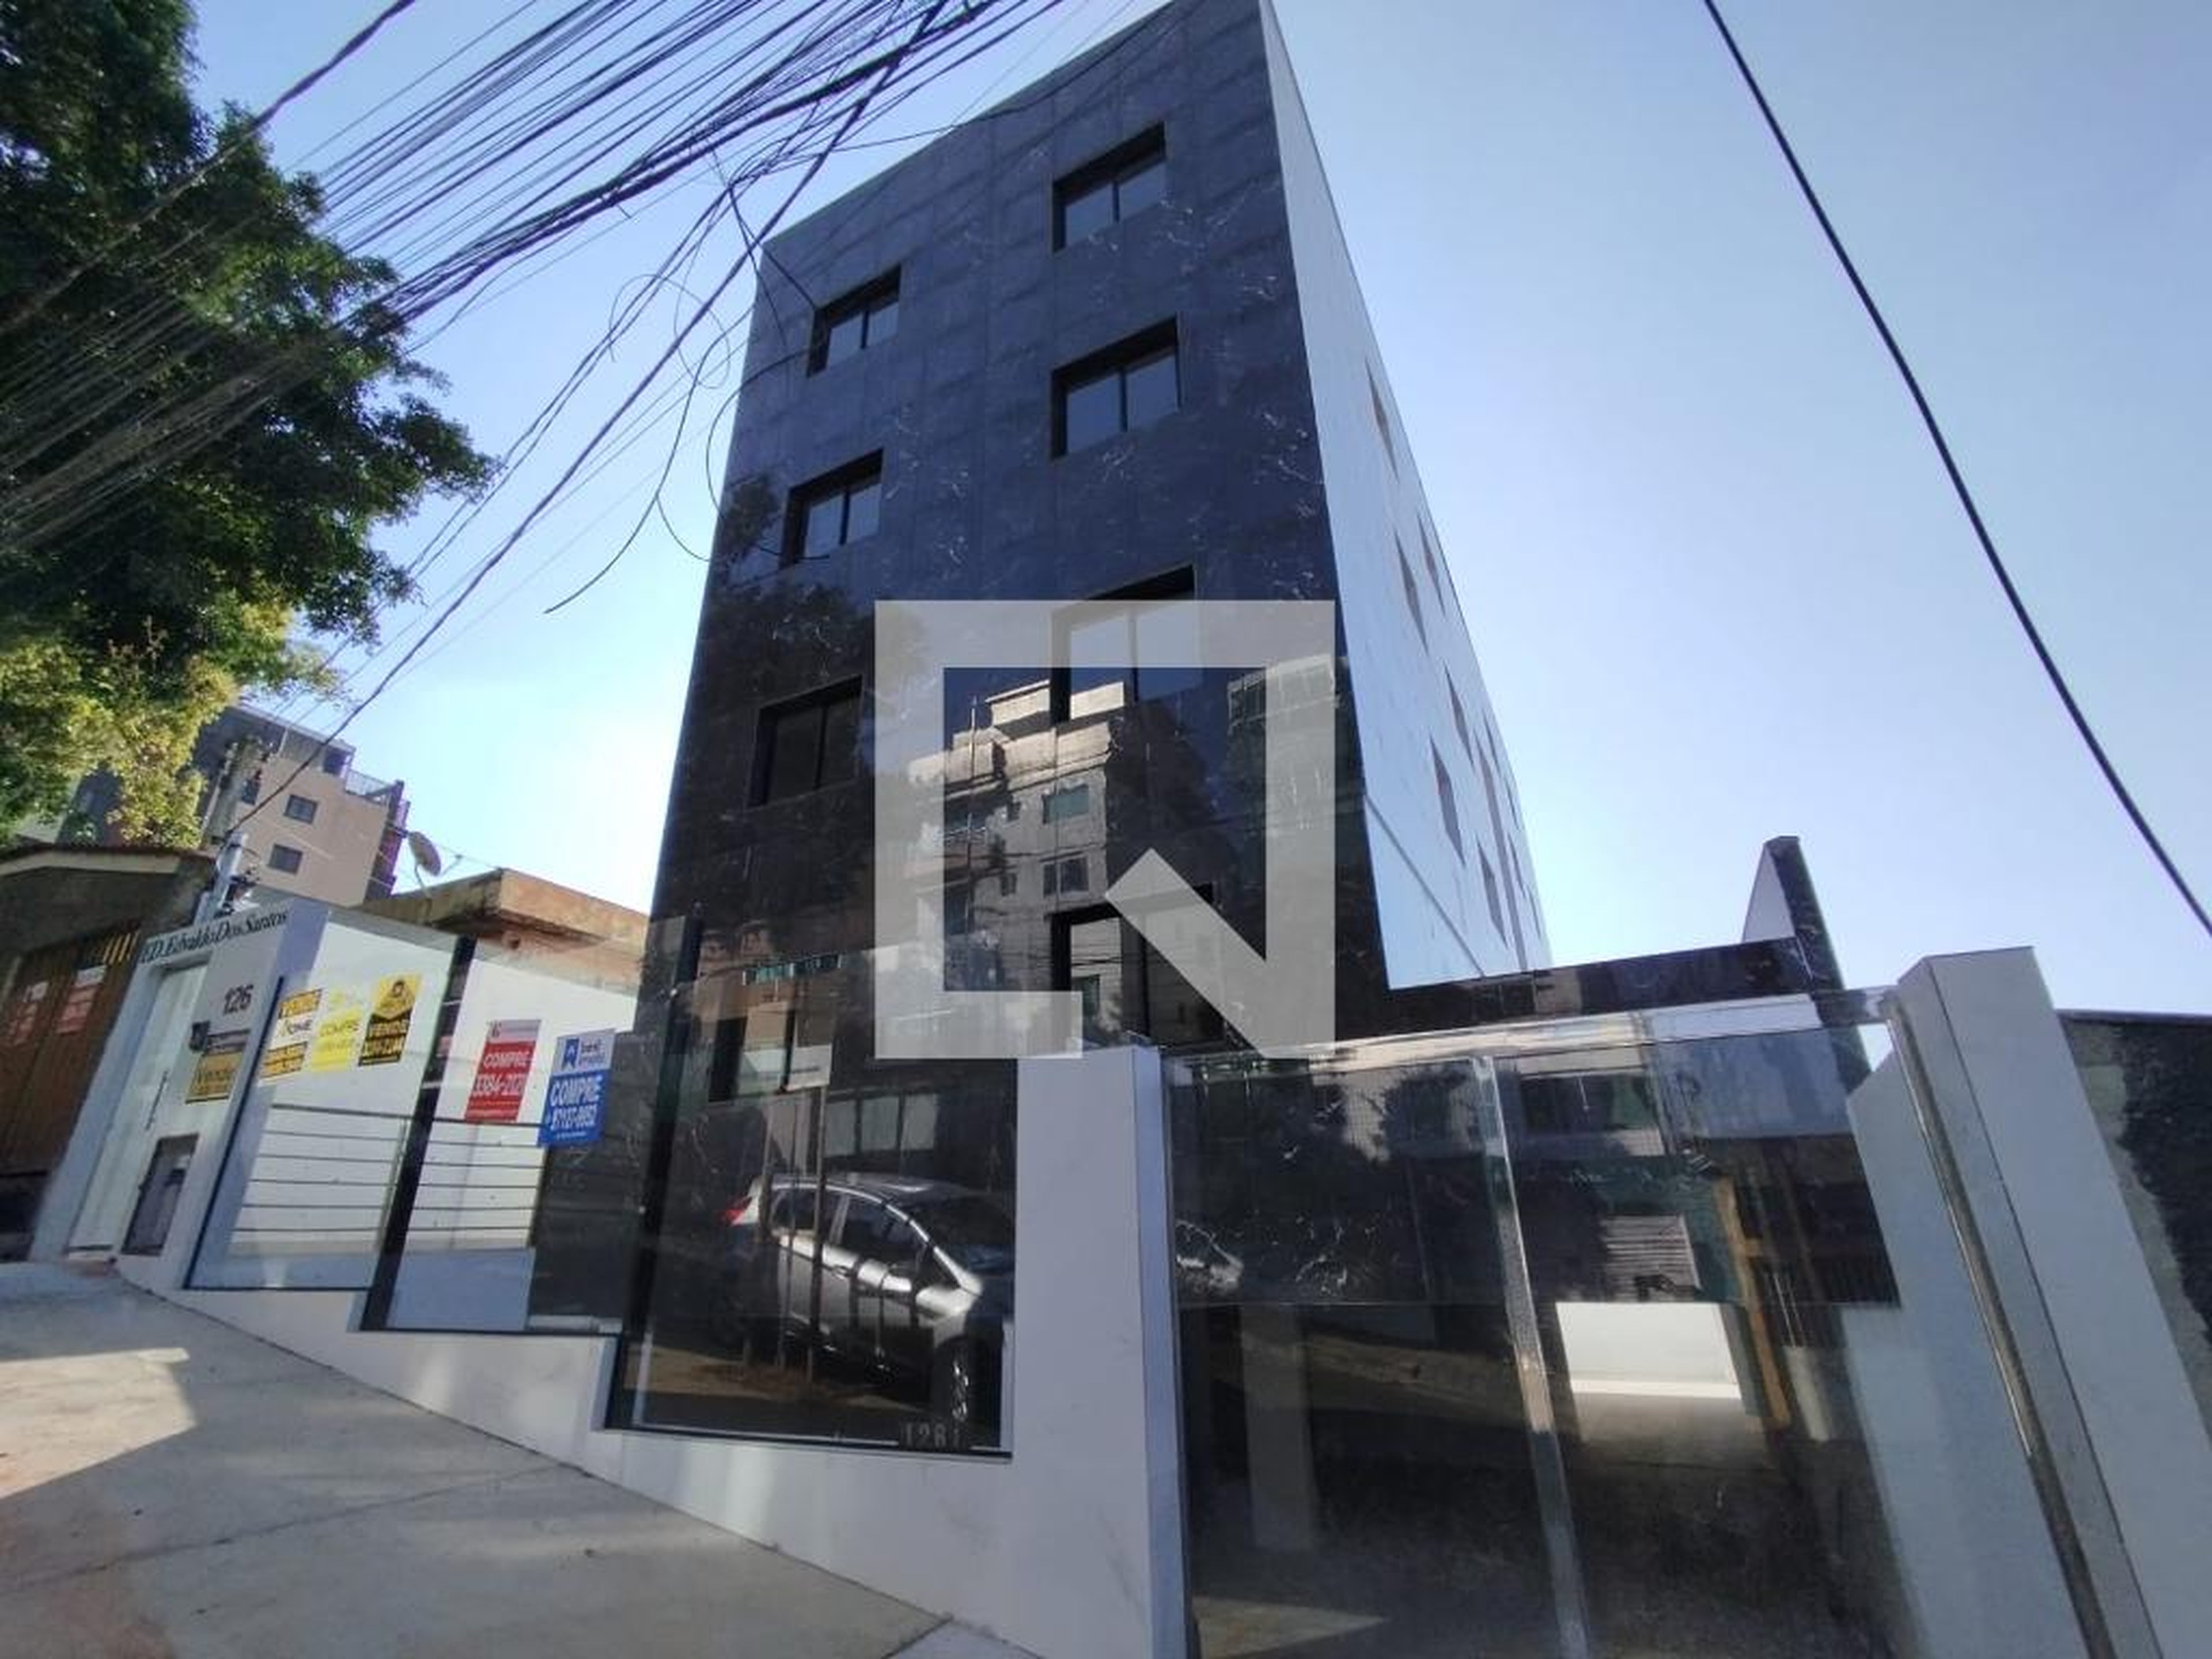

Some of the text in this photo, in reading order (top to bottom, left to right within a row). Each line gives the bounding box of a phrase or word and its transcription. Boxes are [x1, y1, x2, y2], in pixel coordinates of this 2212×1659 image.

[224, 984, 253, 1015] 126
[483, 1050, 531, 1069] COMPRE
[550, 1075, 603, 1107] COMPRE
